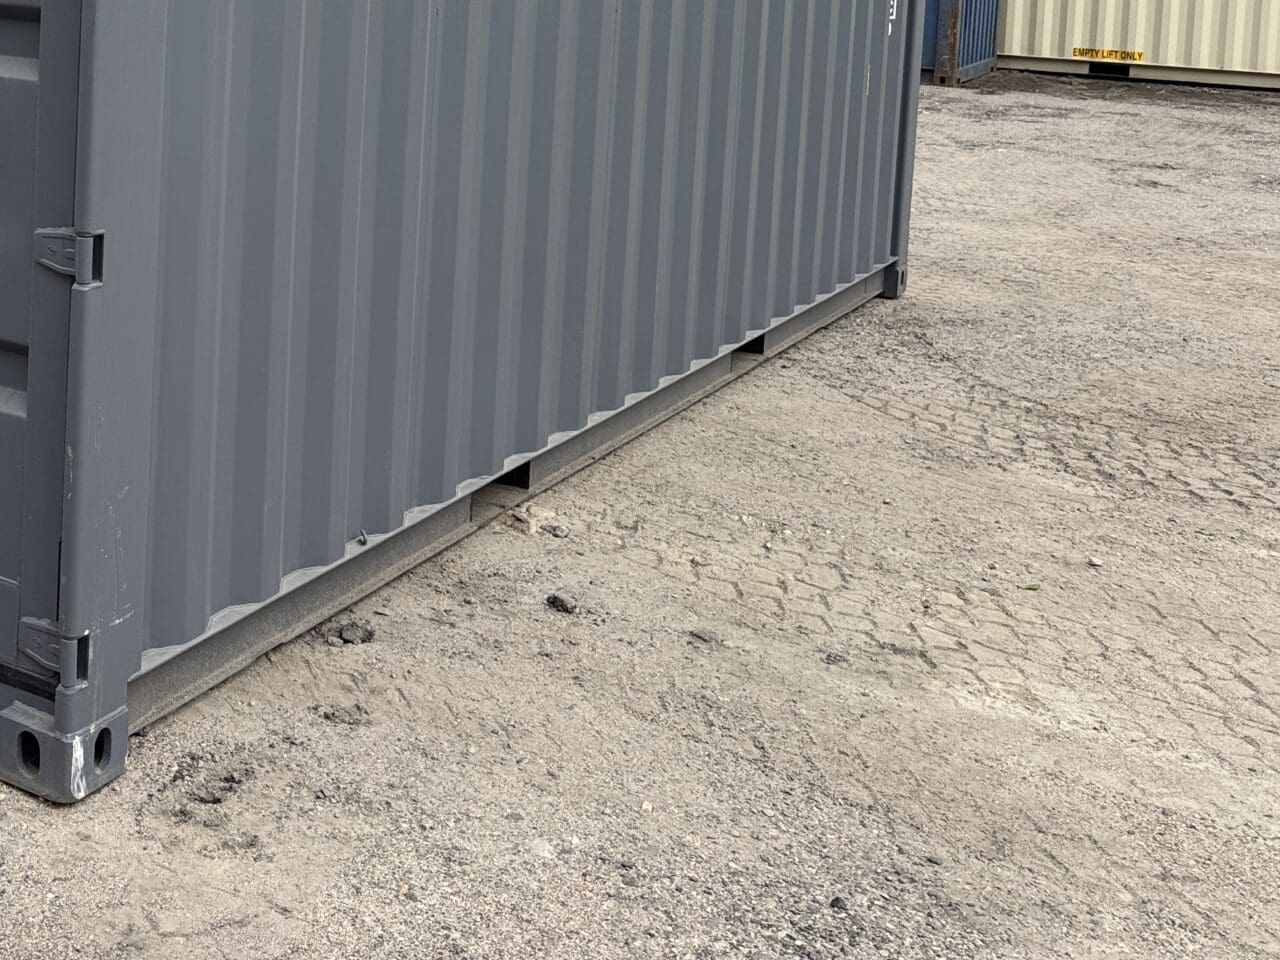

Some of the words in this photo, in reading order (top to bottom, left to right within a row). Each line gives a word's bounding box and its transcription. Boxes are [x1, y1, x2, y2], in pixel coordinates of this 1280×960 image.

[1073, 47, 1100, 57] EMPTY
[1102, 49, 1120, 59] LIFT
[1120, 51, 1143, 60] ONLY
